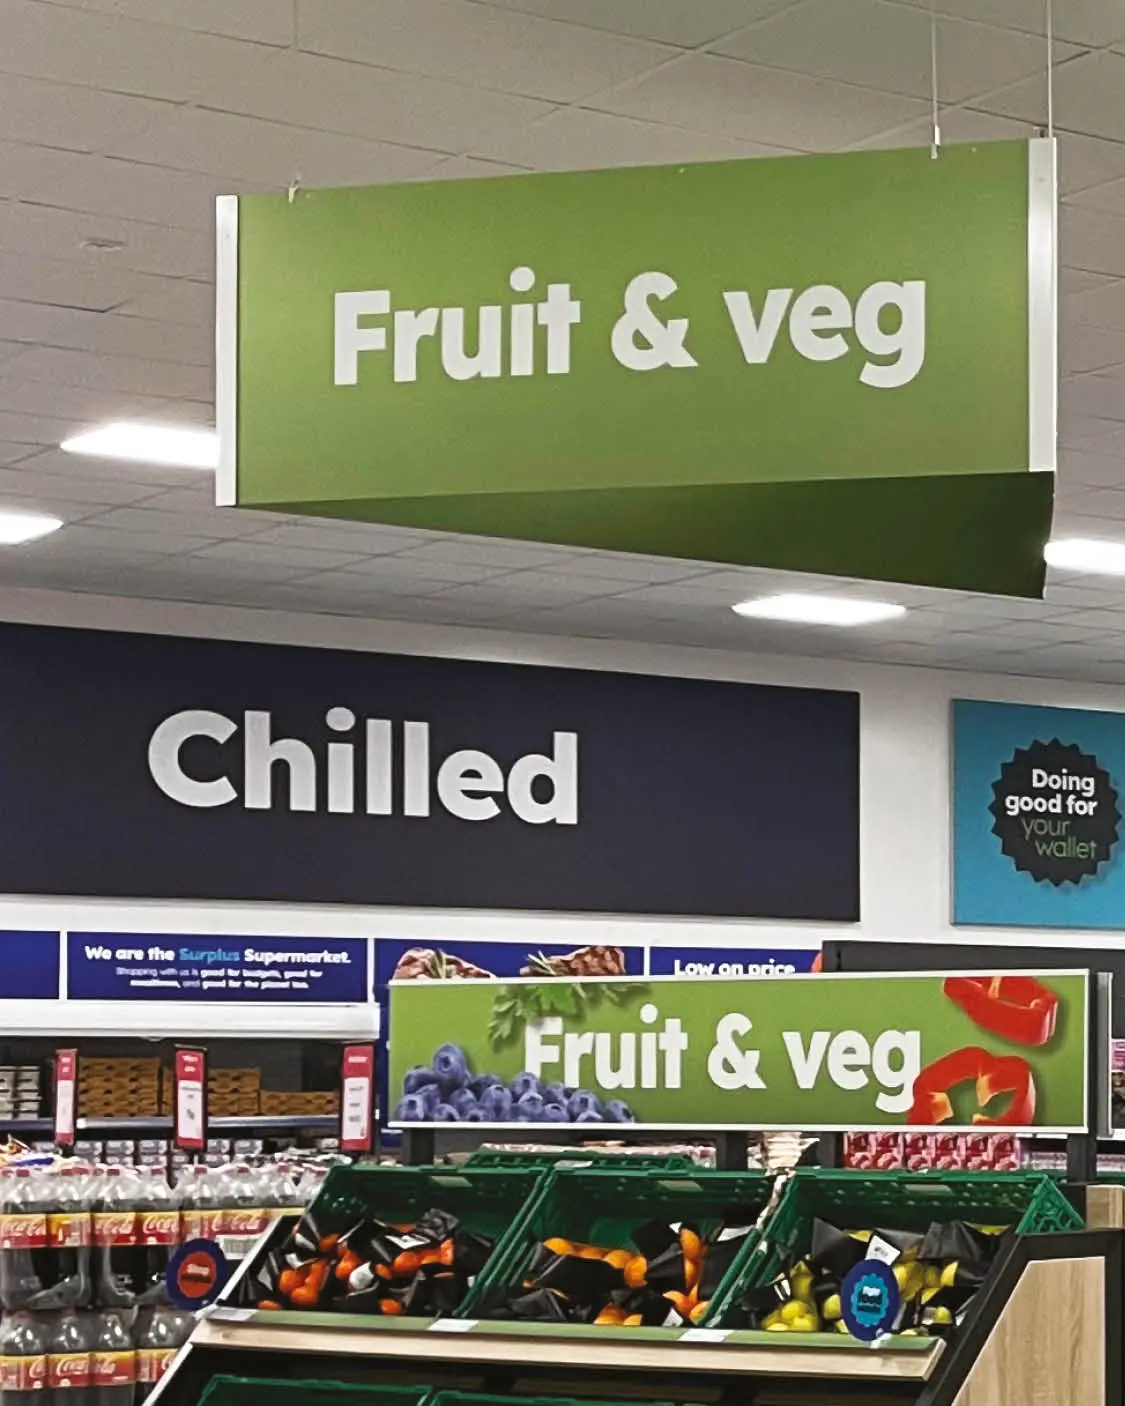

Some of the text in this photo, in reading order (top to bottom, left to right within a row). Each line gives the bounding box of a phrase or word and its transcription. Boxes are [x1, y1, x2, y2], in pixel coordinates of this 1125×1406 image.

[333, 266, 927, 389] Fruit & veg
[147, 706, 579, 825] Chilled
[1032, 768, 1095, 798] Doing
[1005, 793, 1098, 816] good for
[1021, 817, 1070, 841] your
[1034, 836, 1097, 859] wallet
[84, 945, 112, 961] We
[115, 948, 144, 961] are
[147, 946, 176, 961] the
[674, 957, 797, 976] Low on price
[525, 1004, 921, 1114] Fruit & veg
